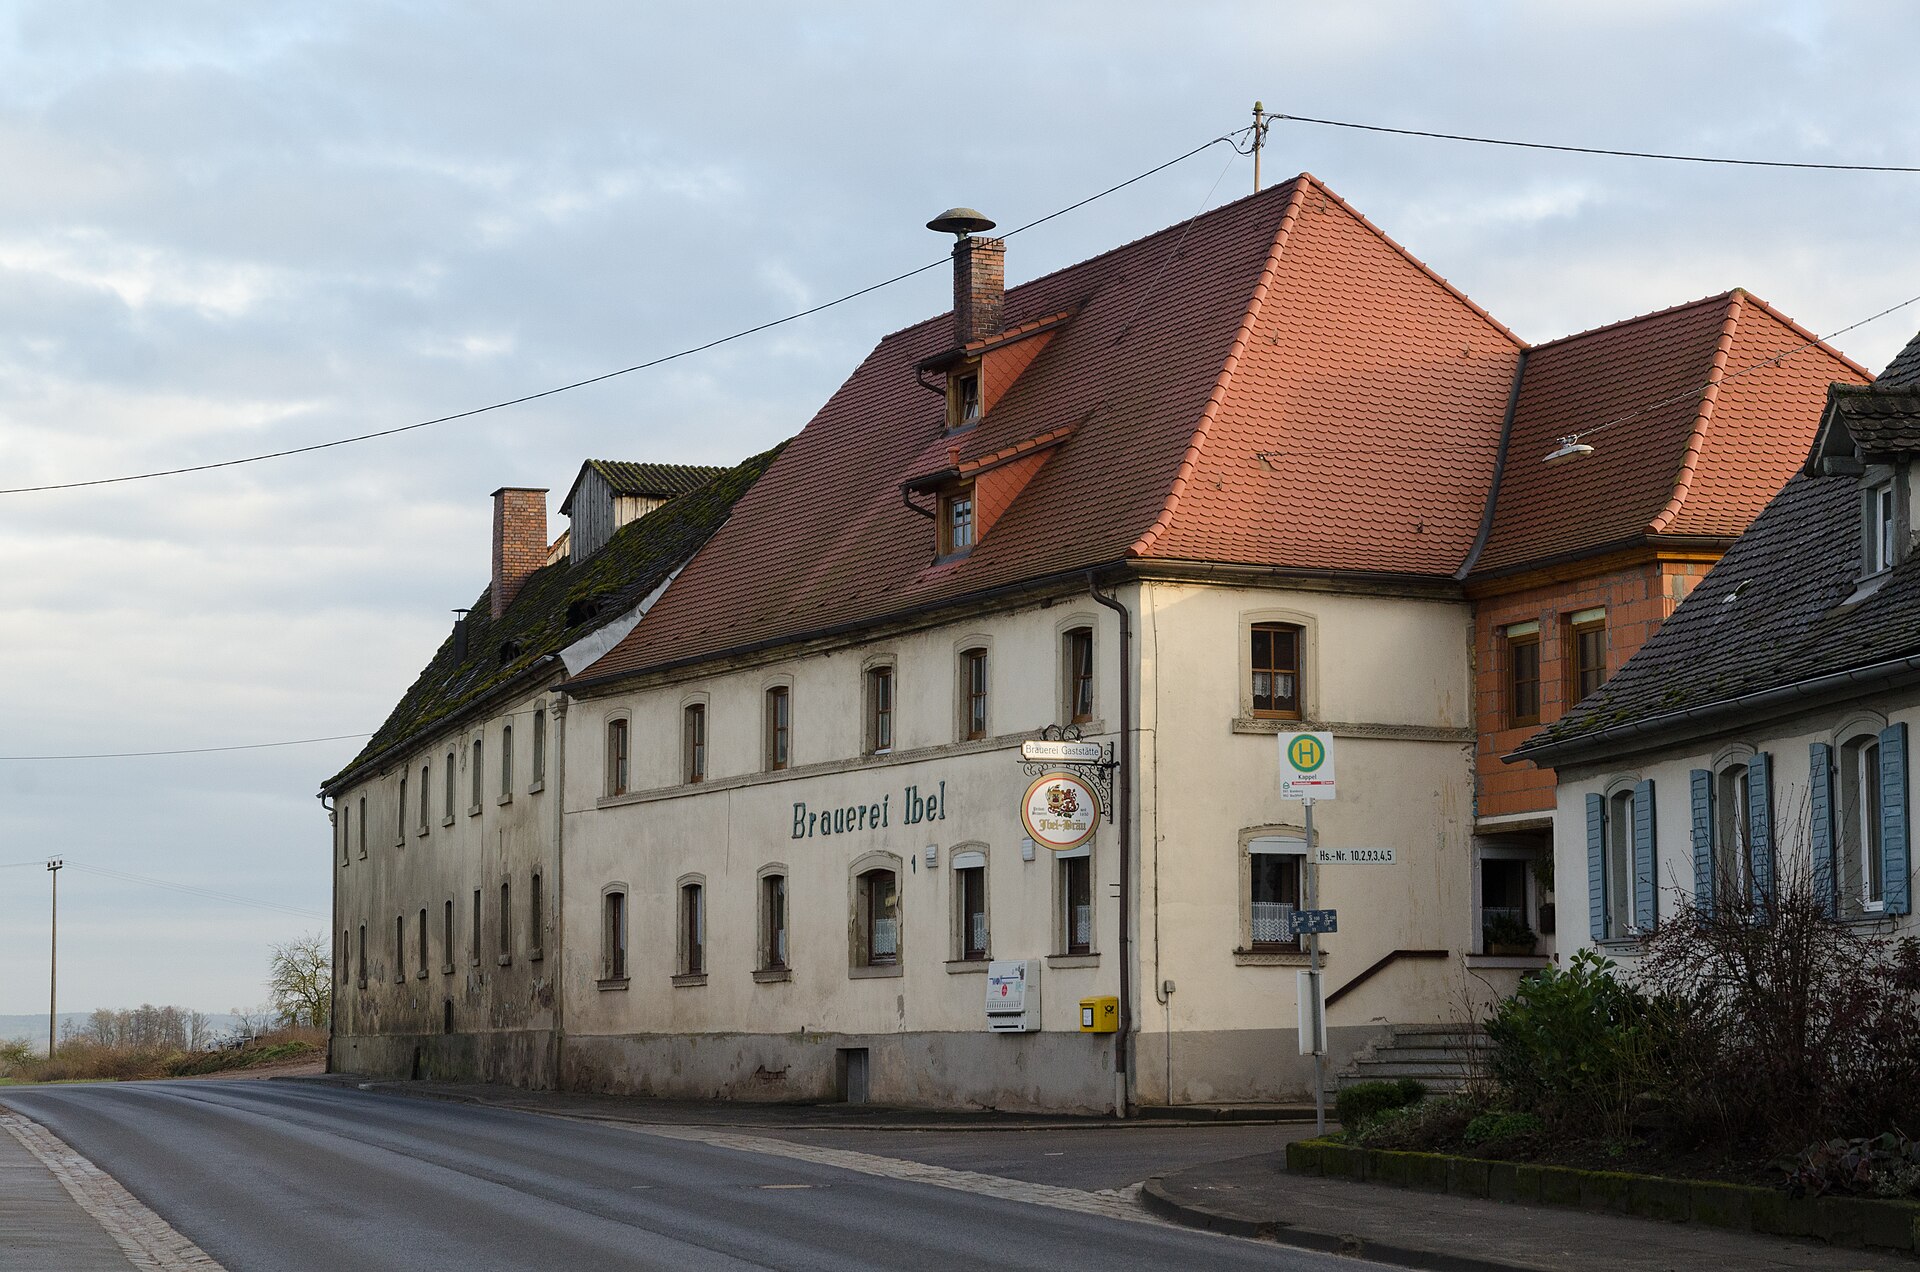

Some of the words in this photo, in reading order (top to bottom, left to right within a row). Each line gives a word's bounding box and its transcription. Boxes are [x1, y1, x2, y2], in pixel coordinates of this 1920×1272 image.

[1026, 744, 1059, 755] Brauerei
[1061, 745, 1099, 756] Gaststätte
[1298, 742, 1315, 764] H
[791, 793, 889, 840] Brauerei
[903, 780, 945, 825] Ibel
[910, 854, 916, 875] 1
[1319, 850, 1347, 861] Hs.-Nr.
